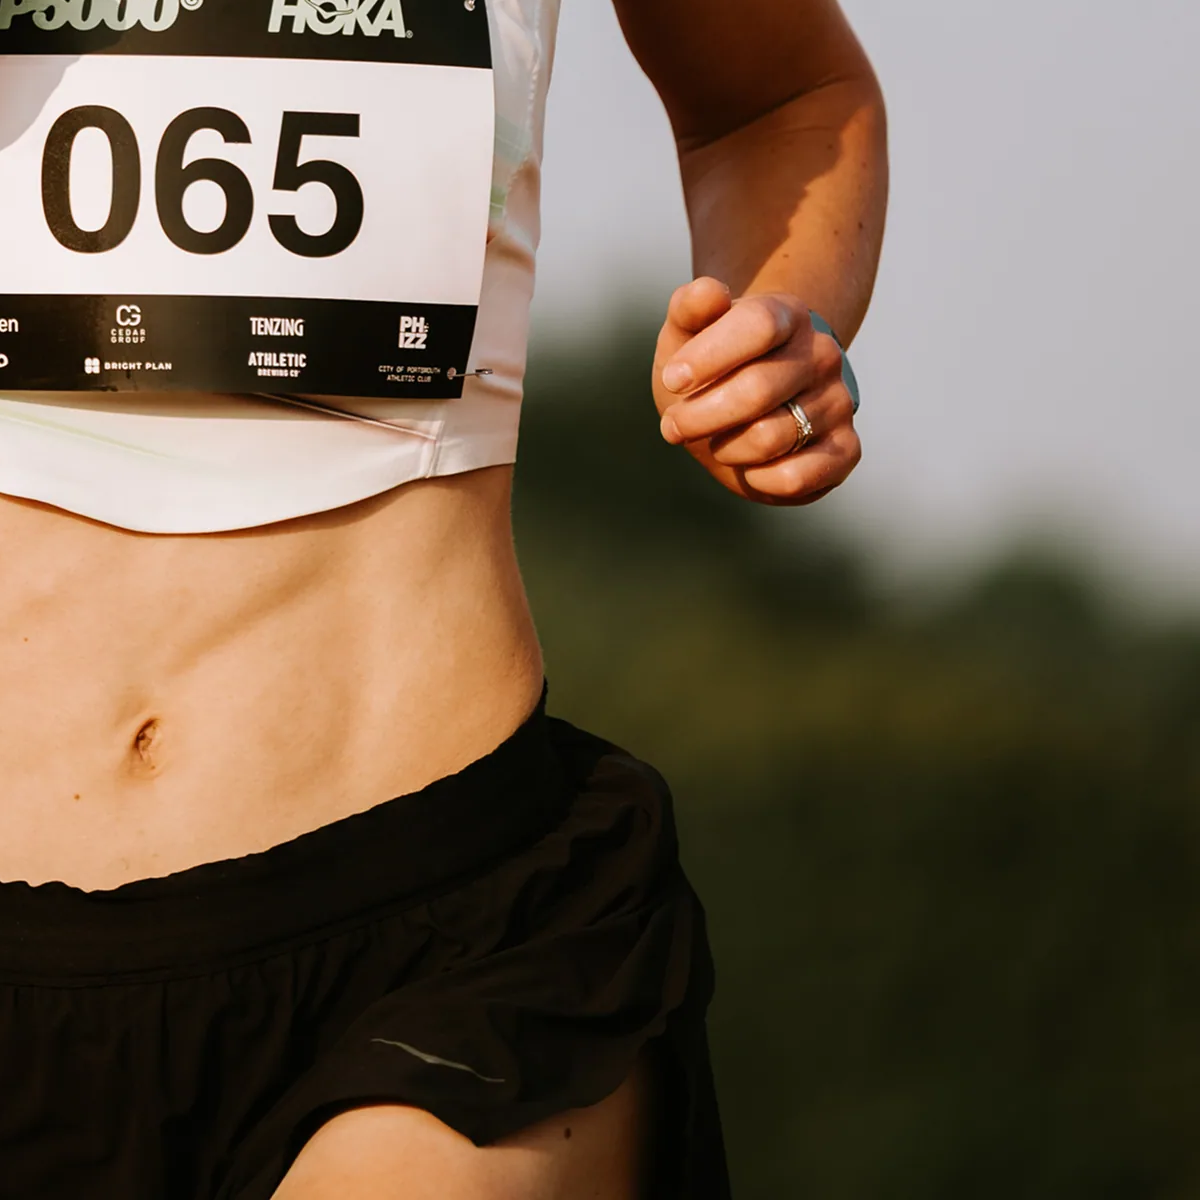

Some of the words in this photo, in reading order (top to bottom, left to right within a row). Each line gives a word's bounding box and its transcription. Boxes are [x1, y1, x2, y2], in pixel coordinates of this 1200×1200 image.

[41, 104, 365, 258] 065
[249, 317, 304, 337] TENZING
[110, 328, 146, 337] CEDAR
[110, 336, 146, 344] GROUP
[248, 351, 307, 368] ATHLETIC
[104, 361, 143, 370] BRIGHT
[145, 362, 172, 371] PLAN
[378, 365, 394, 373] CITY
